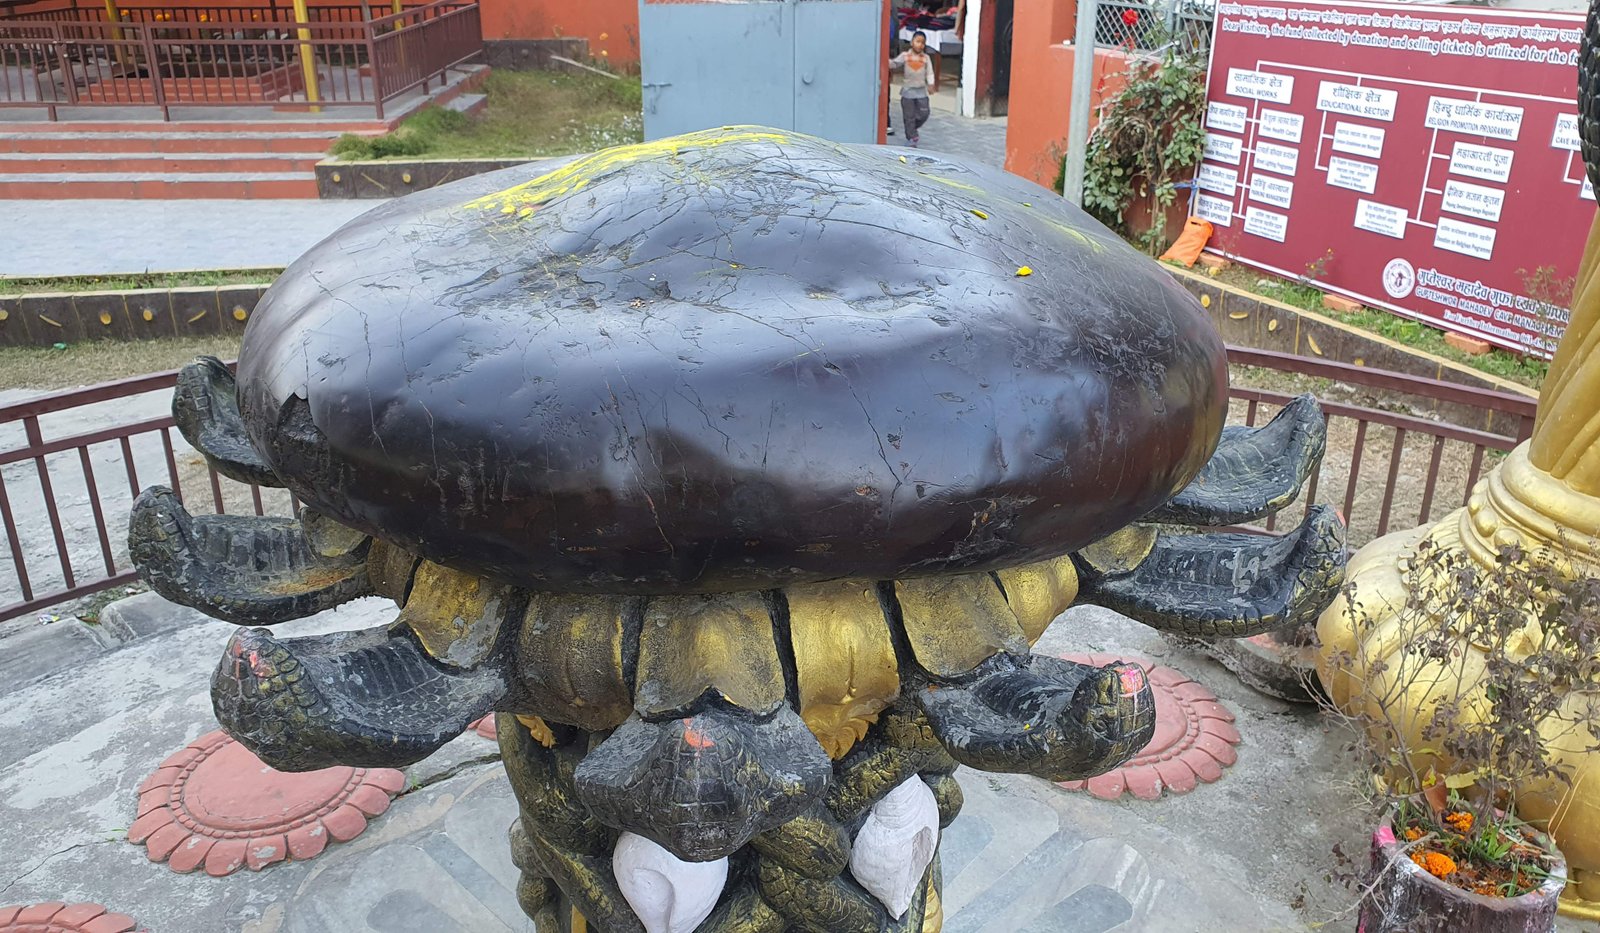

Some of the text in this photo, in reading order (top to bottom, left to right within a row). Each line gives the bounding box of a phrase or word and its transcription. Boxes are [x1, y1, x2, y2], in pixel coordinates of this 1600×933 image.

[1271, 23, 1284, 36] the
[1285, 23, 1303, 39] fund
[1303, 26, 1338, 42] collected
[1339, 29, 1350, 46] by
[1351, 30, 1389, 47] donation
[1389, 35, 1408, 49] and
[1408, 36, 1440, 56] selling
[1441, 38, 1474, 56] tickets
[1474, 40, 1485, 57] is
[1486, 42, 1528, 60] utilized
[1528, 45, 1546, 62] for
[1547, 47, 1567, 64] the
[1235, 86, 1278, 99] SOCIAL WORKS
[1320, 99, 1390, 117] EDUCATIONAL SECTOR
[1428, 117, 1514, 137] RELIGION PROMOTION PROGRAMME
[1555, 136, 1569, 145] CAVE
[1417, 268, 1455, 291] गुप्तेश्वर
[1455, 279, 1490, 300] महादेव
[1458, 298, 1494, 318] MAHADEV
[1494, 308, 1514, 323] CAVE
